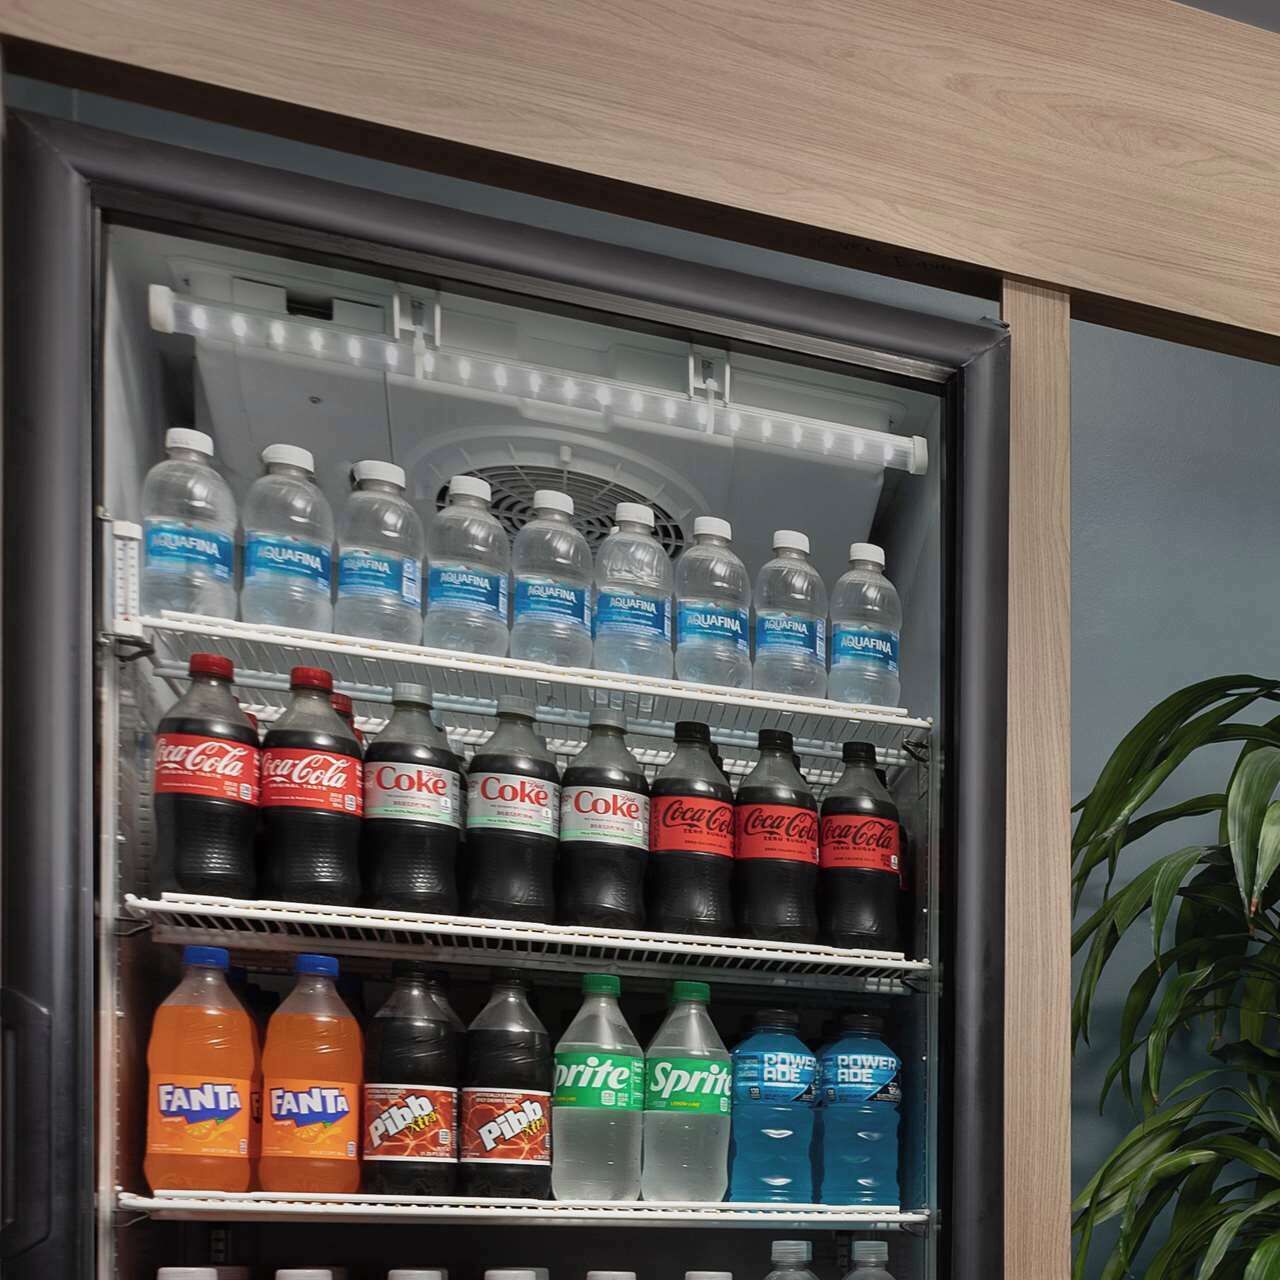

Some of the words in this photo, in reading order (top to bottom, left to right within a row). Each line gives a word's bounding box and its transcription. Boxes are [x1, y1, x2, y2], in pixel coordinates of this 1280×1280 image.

[152, 531, 220, 558] AQUAFINA
[258, 545, 322, 573] AQUAFINA
[343, 556, 391, 575] AQUAFINA
[440, 571, 491, 591] AQUAFINA
[527, 583, 576, 603] AQUAFINA
[609, 596, 657, 614] AQUAFINA
[687, 612, 742, 633] AQUAFINA
[764, 617, 808, 636] AQUAFINA
[840, 635, 892, 655] AQUAFINA
[375, 766, 447, 796] Coke
[480, 776, 548, 807] Coke
[574, 790, 640, 820] Coke
[661, 799, 734, 836] Coca-Col
[555, 1056, 631, 1090] prite
[763, 1069, 801, 1082] ADE
[838, 1055, 896, 1070] POWER
[838, 1069, 873, 1082] ADE
[158, 1083, 242, 1112] FANTA
[271, 1088, 350, 1115] FANTA
[369, 1094, 433, 1148] Pibb
[479, 1100, 544, 1151] Pibb
